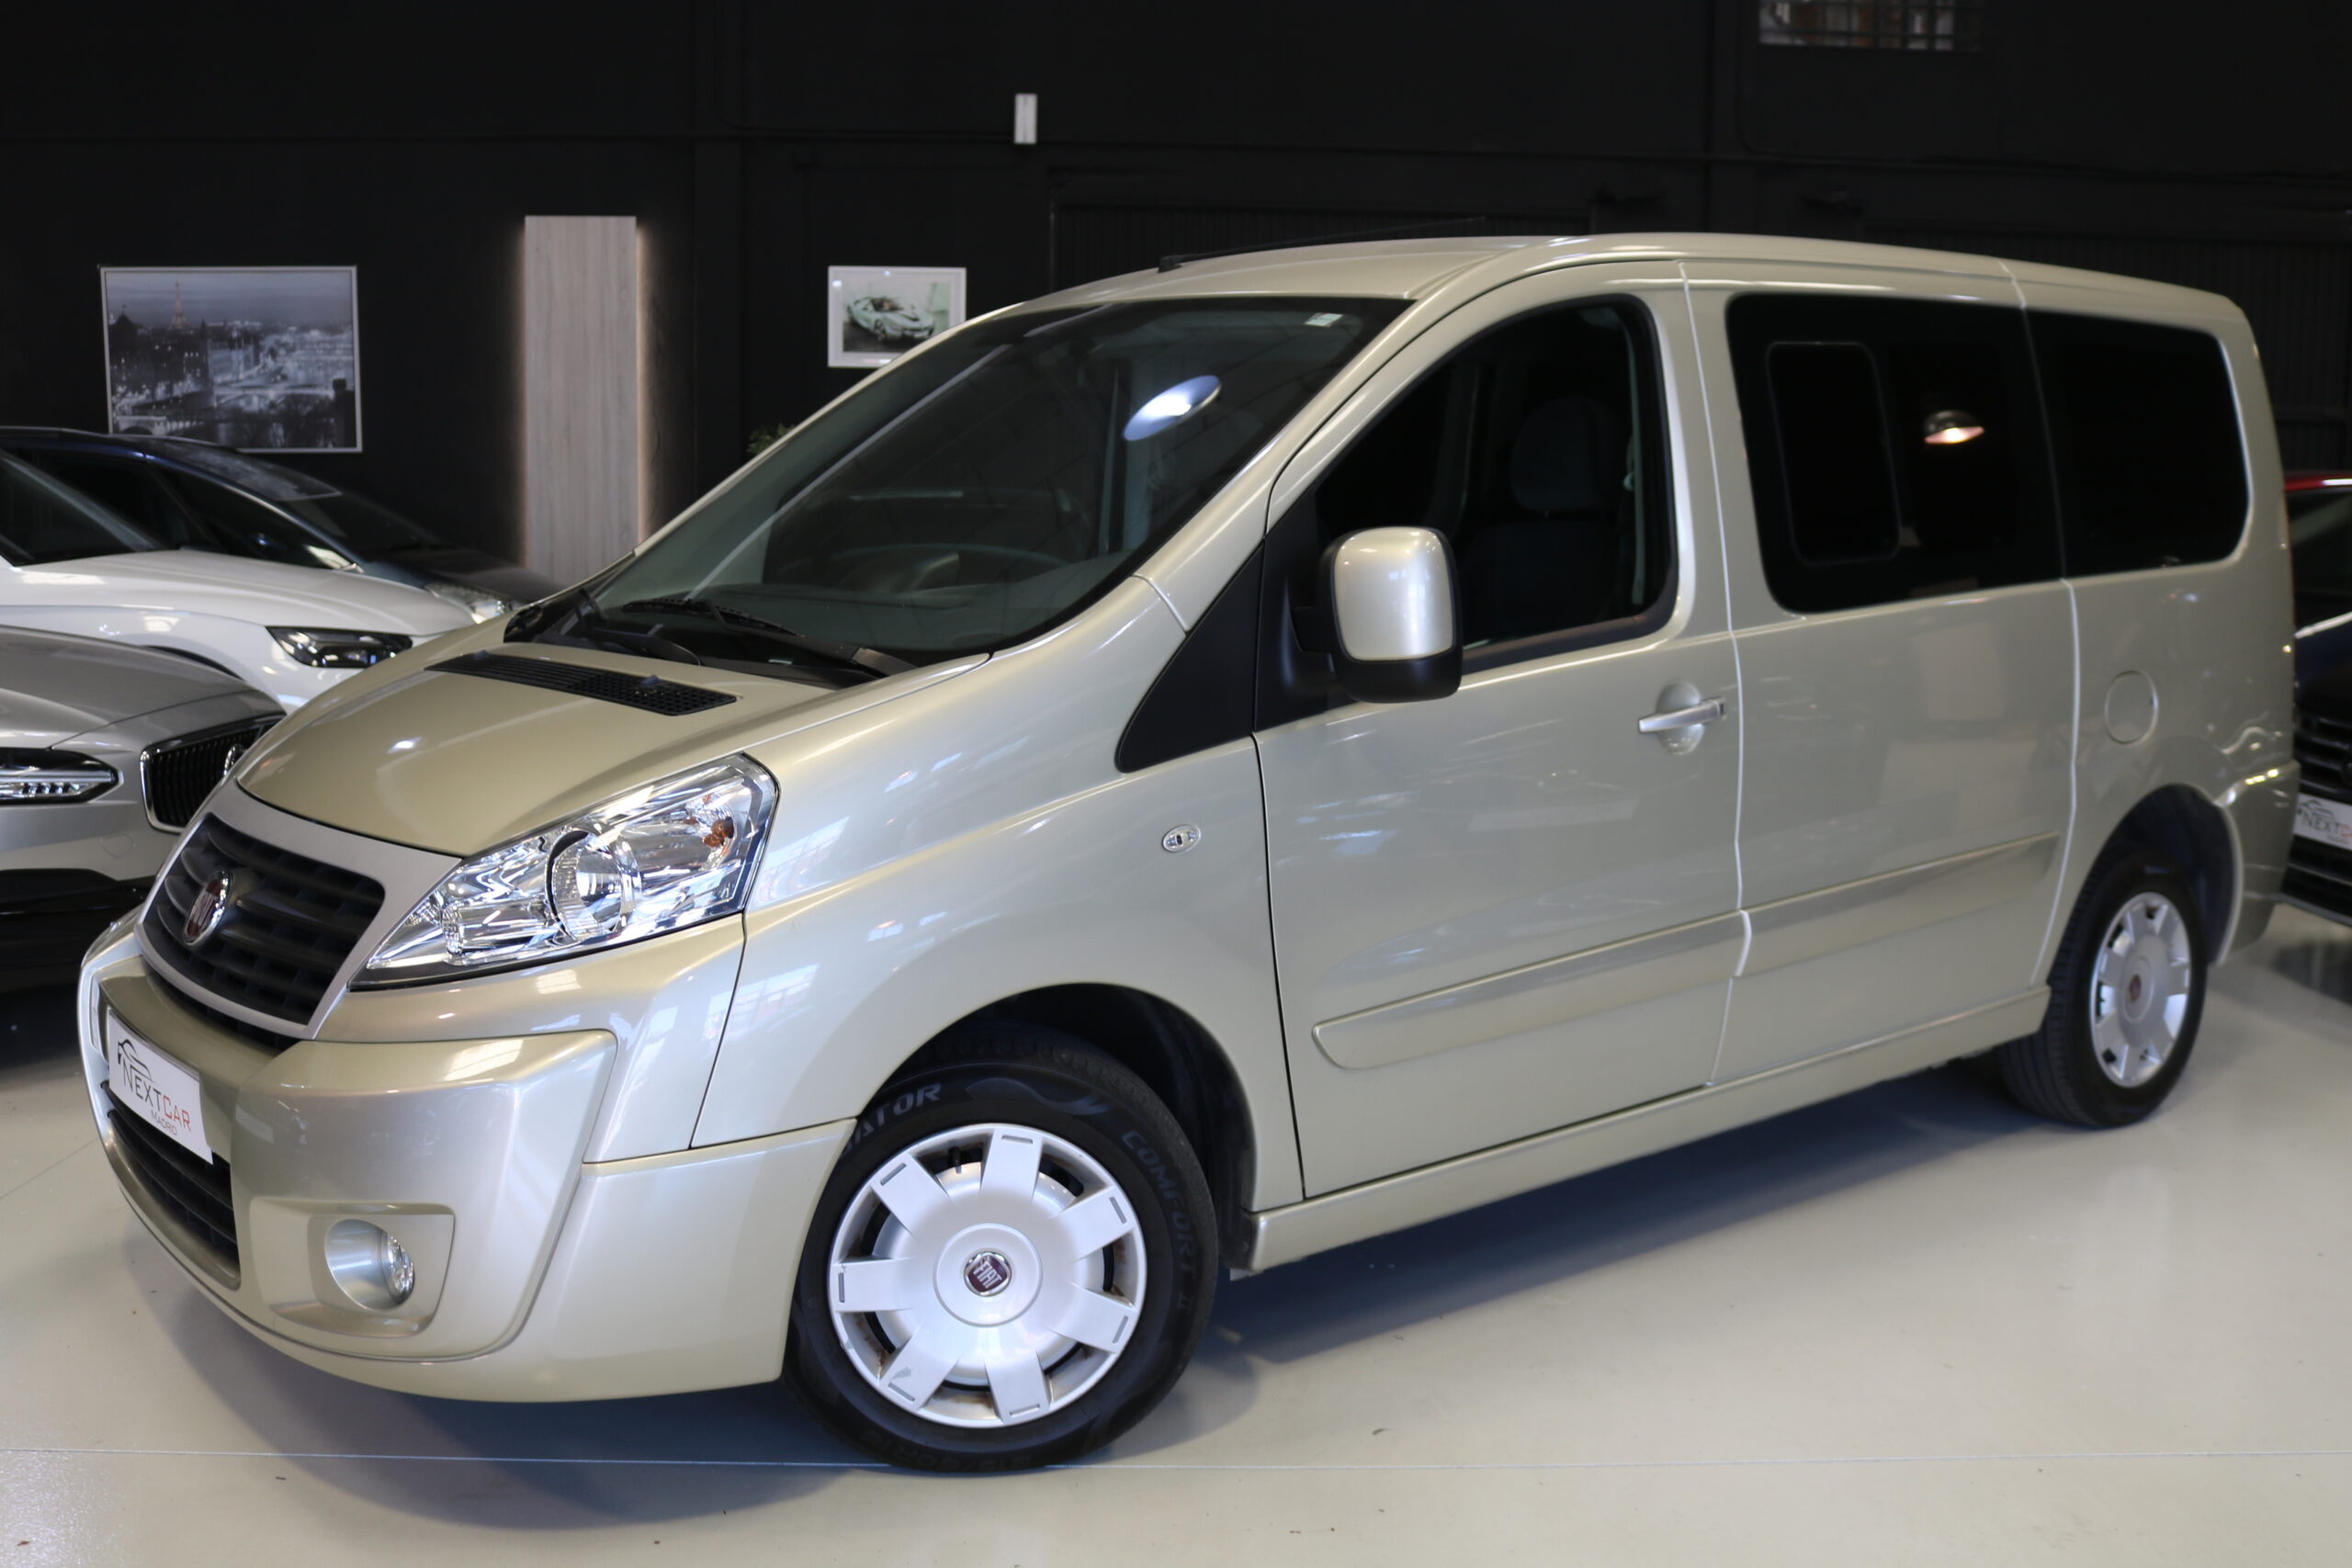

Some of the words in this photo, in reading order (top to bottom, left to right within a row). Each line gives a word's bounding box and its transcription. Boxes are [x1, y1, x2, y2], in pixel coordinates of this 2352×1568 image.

[122, 1057, 192, 1132] NEXTCAR
[151, 1110, 177, 1136] MADRID
[845, 1082, 942, 1154] ATOR
[1121, 1130, 1197, 1281] COMFORT
[973, 1261, 1002, 1289] FIAT
